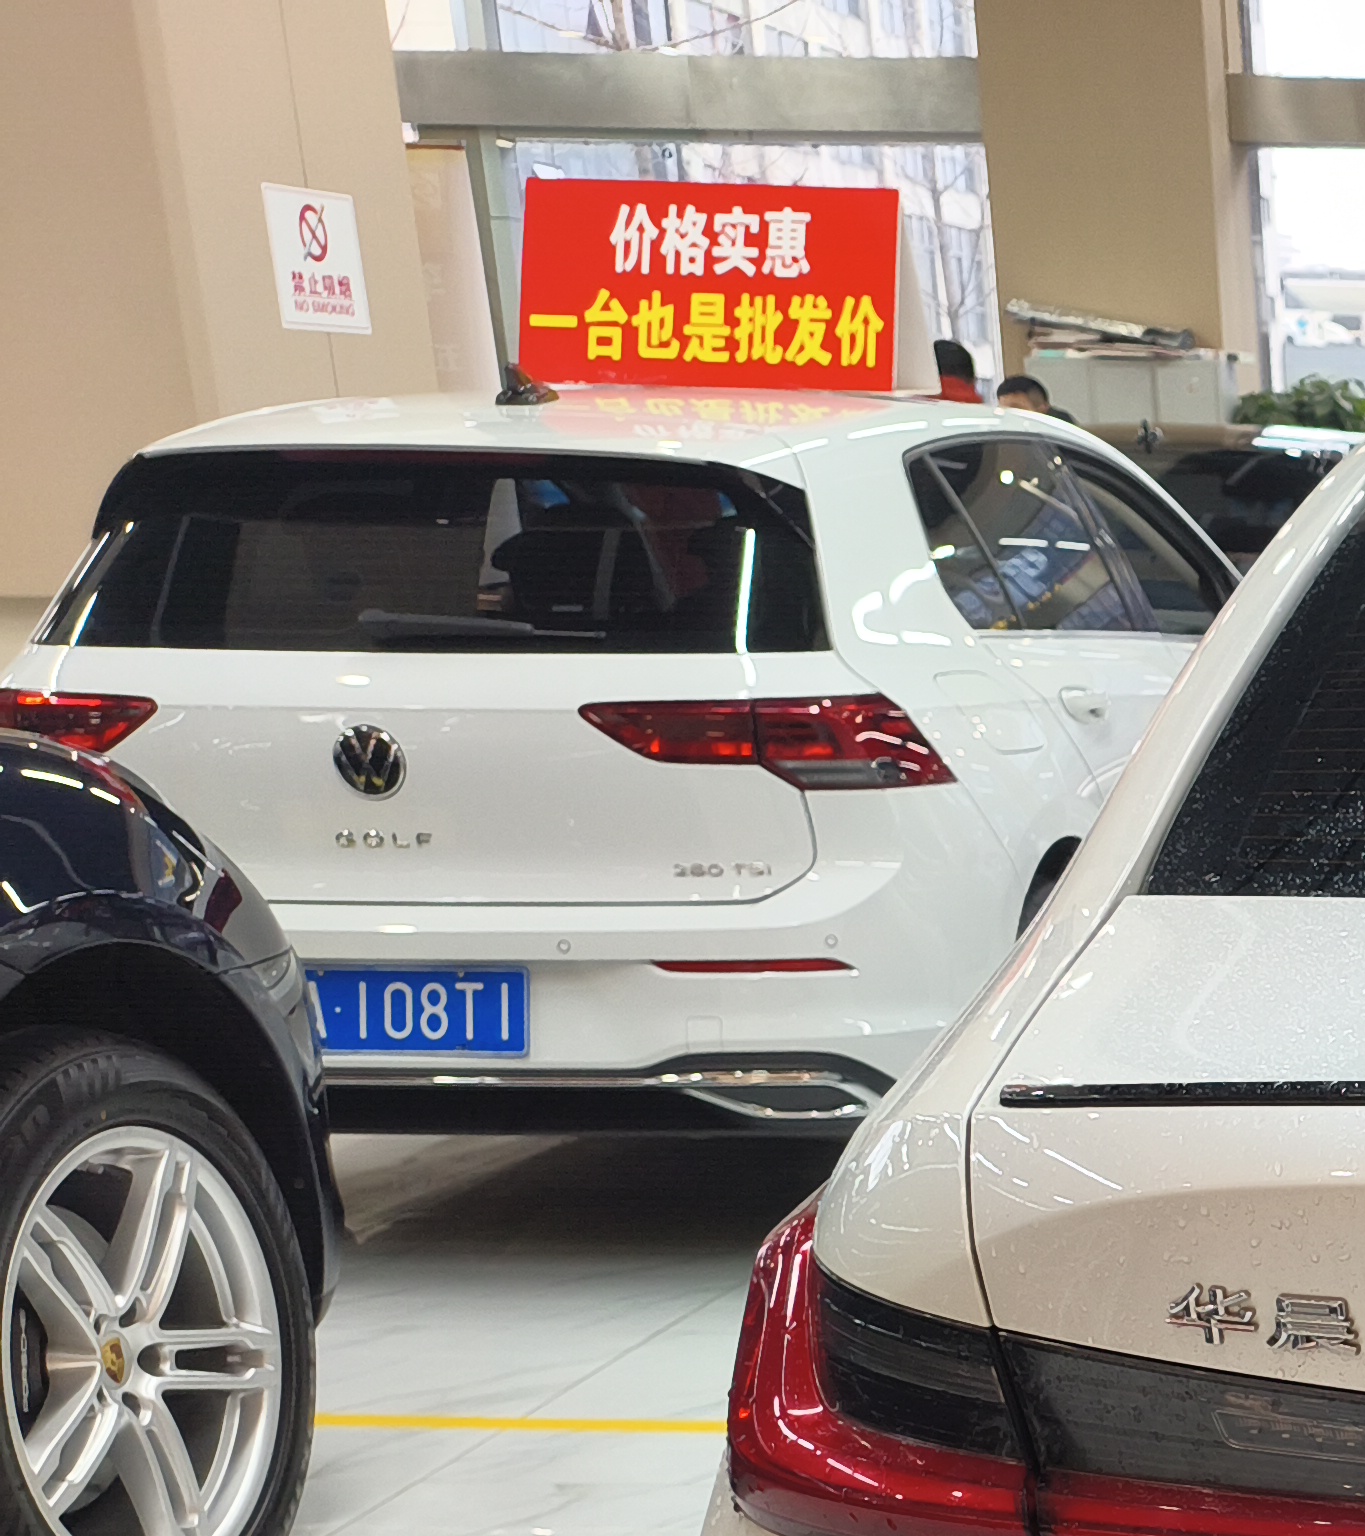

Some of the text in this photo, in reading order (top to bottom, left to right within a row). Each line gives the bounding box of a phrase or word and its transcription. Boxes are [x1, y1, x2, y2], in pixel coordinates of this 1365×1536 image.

[610, 203, 813, 279] 价格实惠
[528, 288, 885, 368] 一台也是批发价
[335, 829, 433, 848] GOLF
